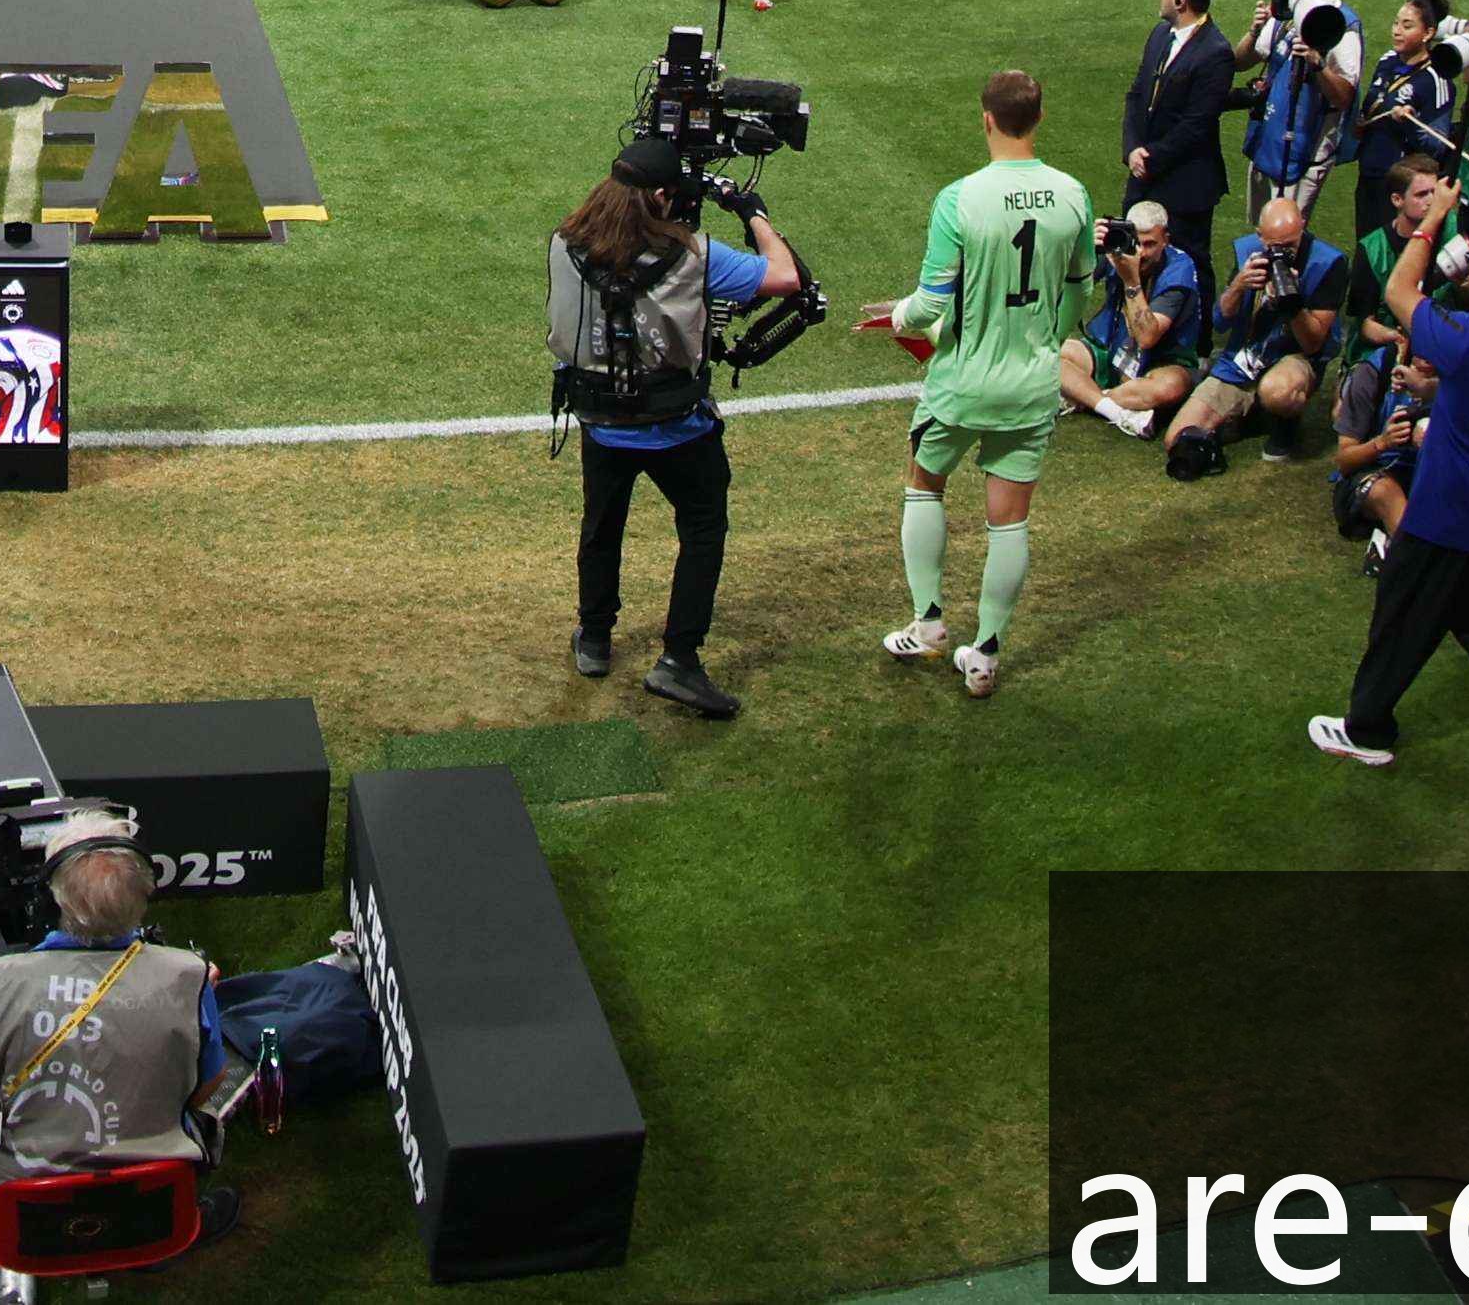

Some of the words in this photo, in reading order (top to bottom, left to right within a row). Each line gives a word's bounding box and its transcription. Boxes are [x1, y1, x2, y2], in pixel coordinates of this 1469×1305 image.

[1004, 190, 1055, 210] NEUER
[1005, 219, 1040, 308] 1
[48, 974, 97, 1004] HB
[367, 883, 387, 984] FIFA
[386, 966, 413, 1079] CLUB
[102, 1101, 119, 1149] CUP
